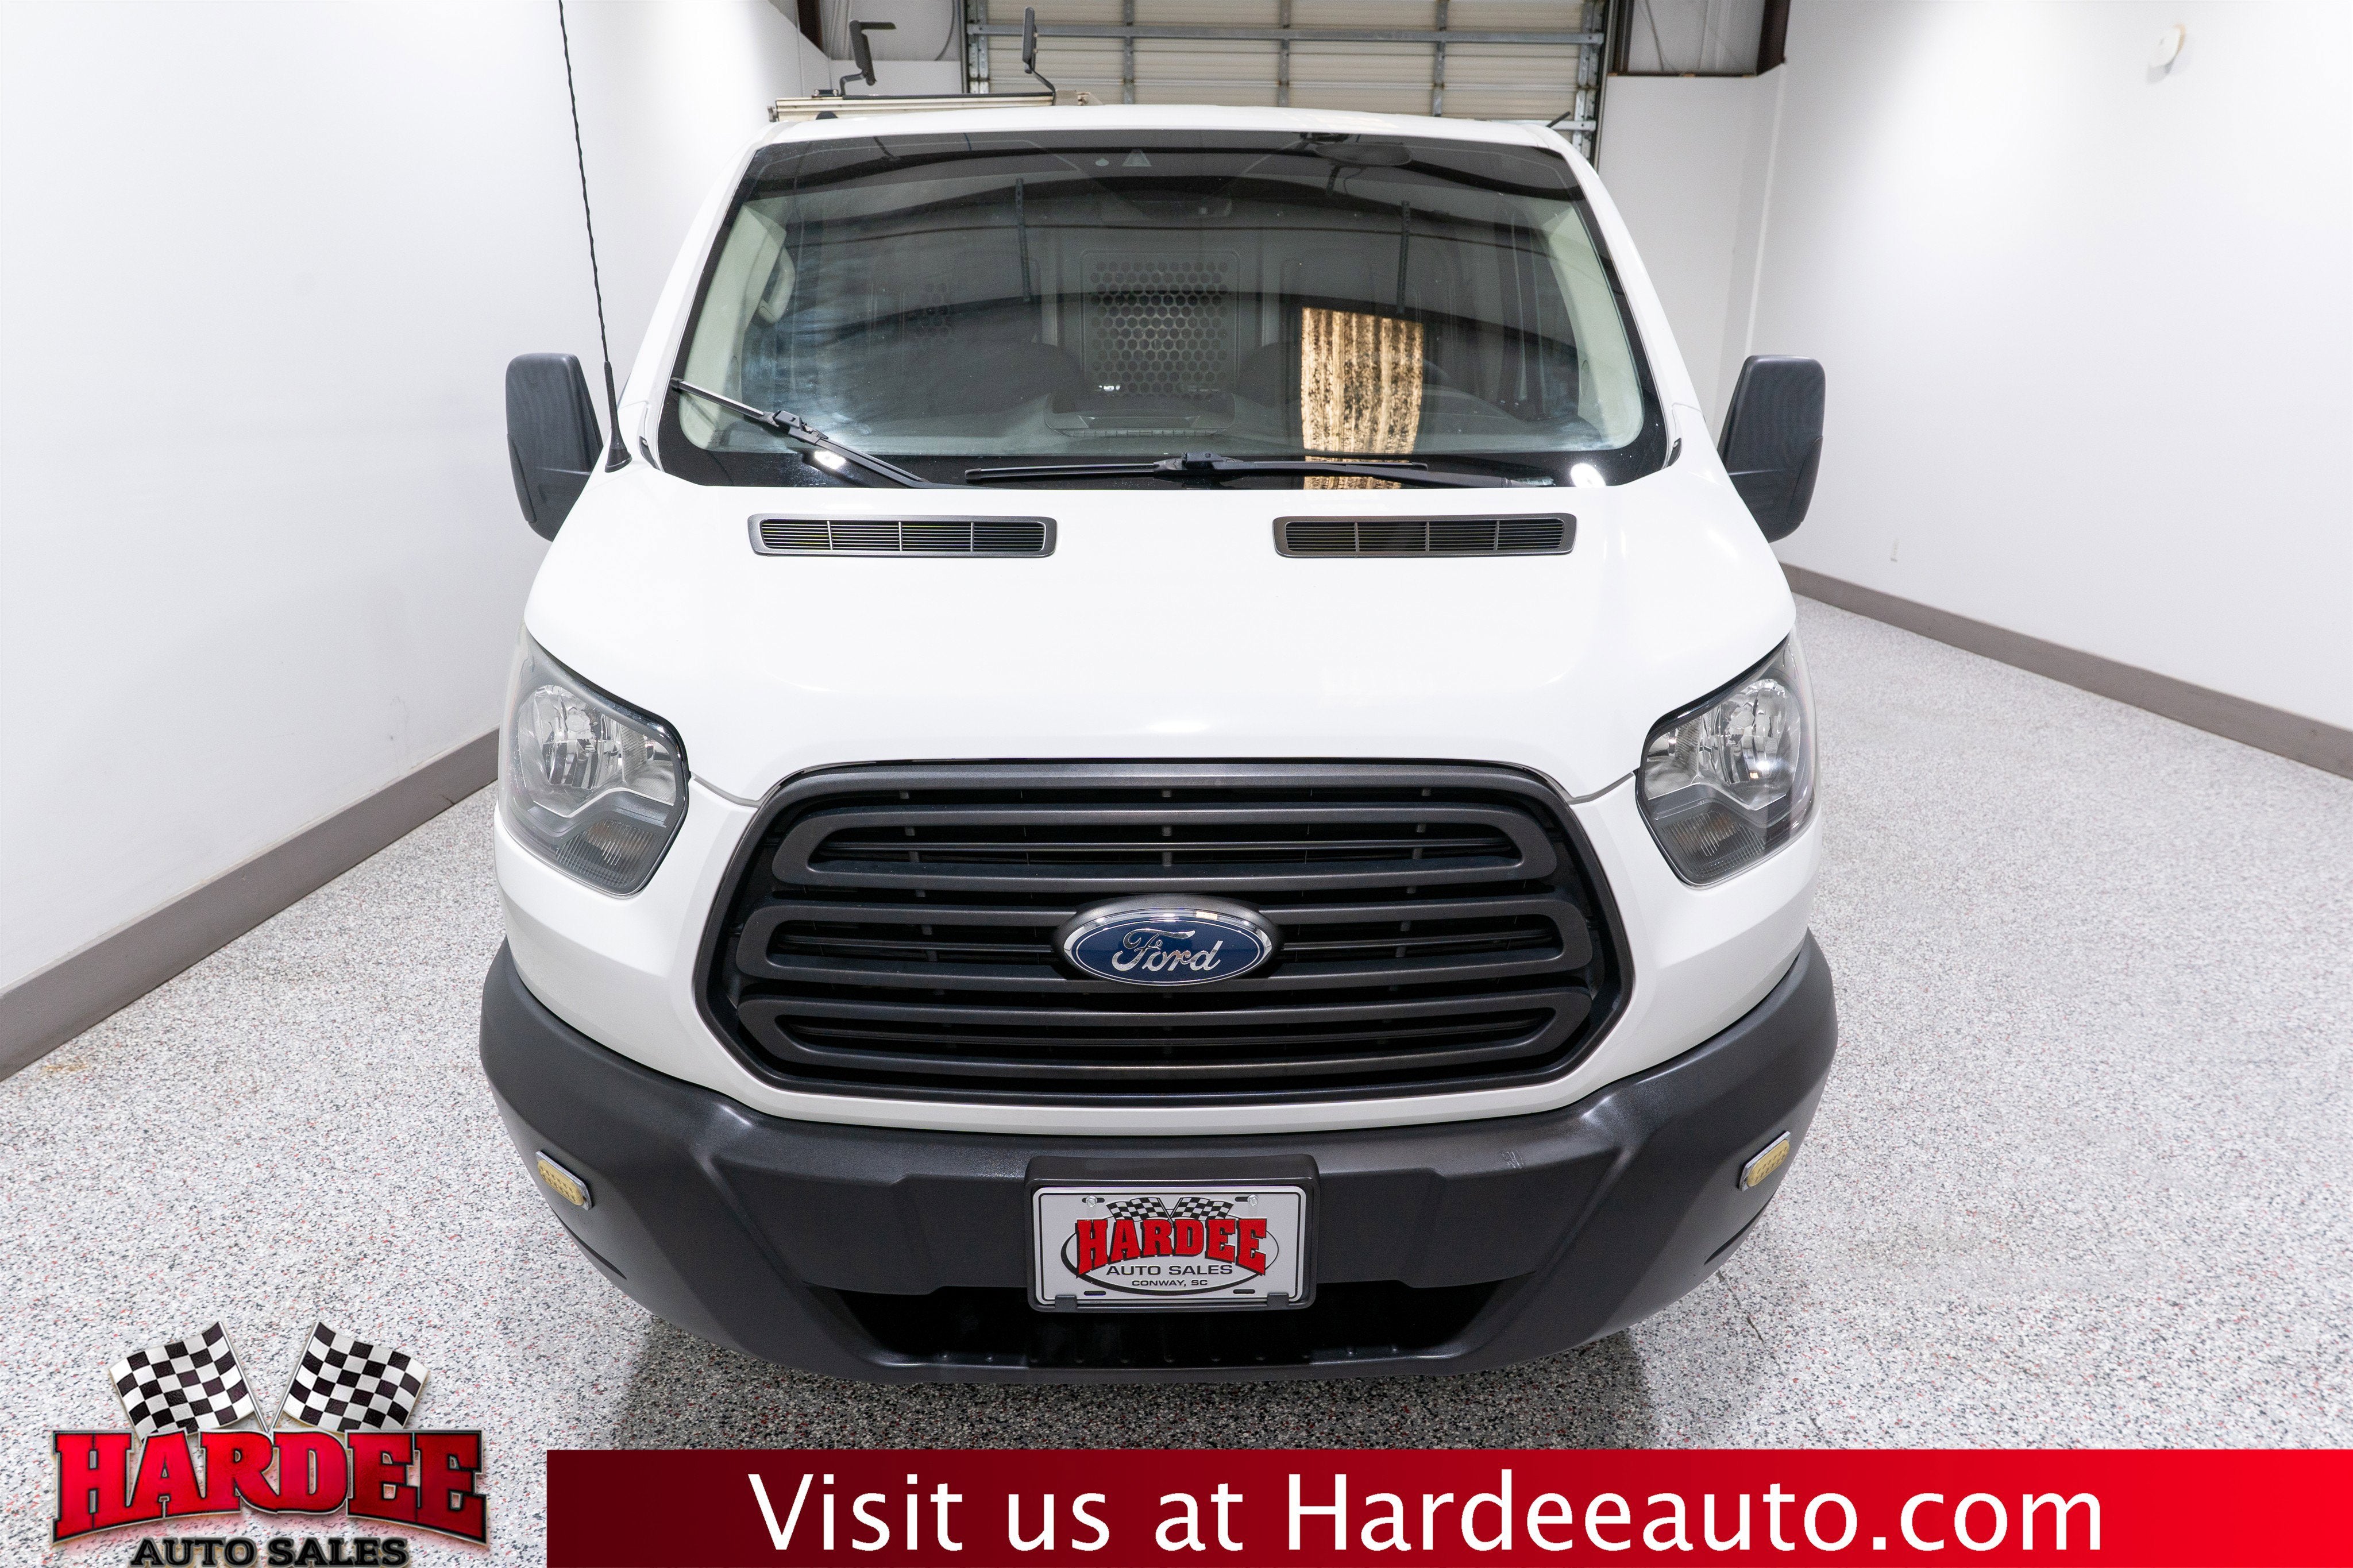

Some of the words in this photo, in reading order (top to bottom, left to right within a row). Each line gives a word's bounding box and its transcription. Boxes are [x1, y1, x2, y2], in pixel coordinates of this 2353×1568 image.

[1112, 928, 1222, 972] Ford
[1075, 1218, 1267, 1278] HARDEE
[1106, 1265, 1161, 1275] AUTO
[1168, 1265, 1233, 1275] SALES
